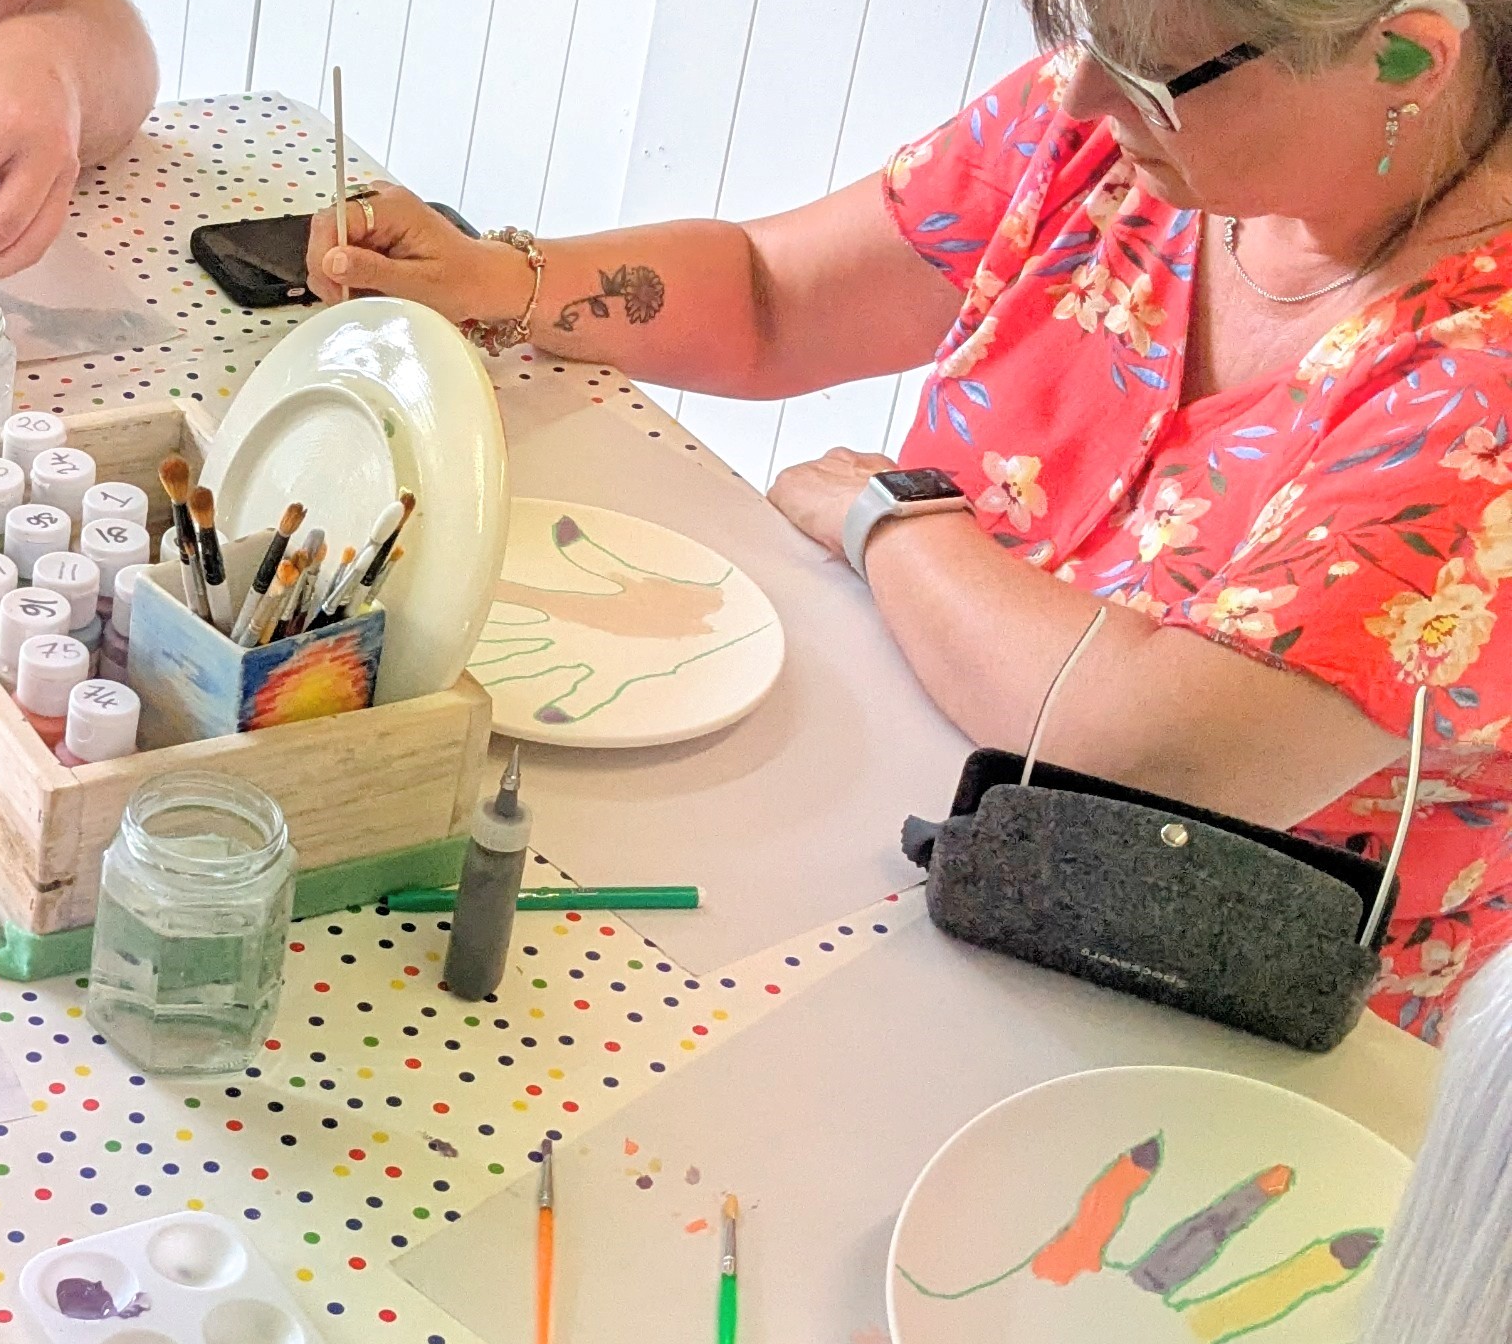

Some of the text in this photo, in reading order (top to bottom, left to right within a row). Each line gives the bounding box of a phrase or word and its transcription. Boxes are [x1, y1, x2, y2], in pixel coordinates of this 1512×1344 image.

[16, 416, 51, 432] 20
[96, 526, 129, 544] 18
[58, 561, 78, 581] 11
[36, 642, 81, 660] 75
[83, 685, 119, 709] 74
